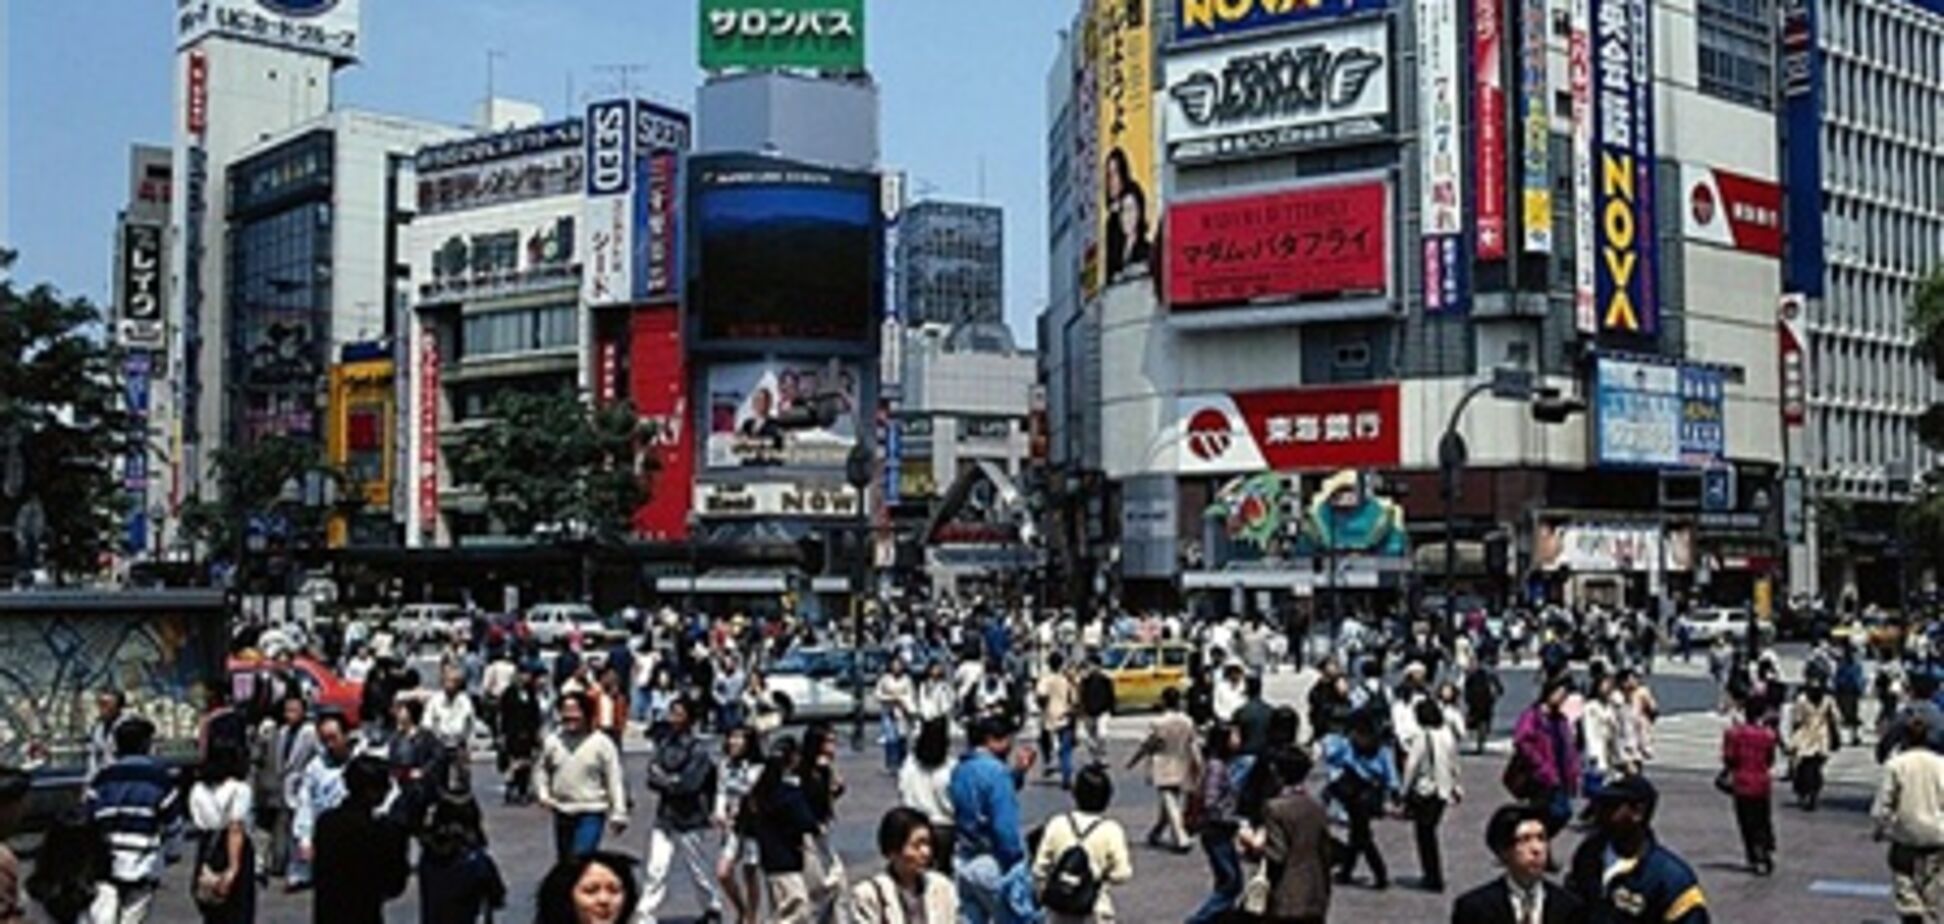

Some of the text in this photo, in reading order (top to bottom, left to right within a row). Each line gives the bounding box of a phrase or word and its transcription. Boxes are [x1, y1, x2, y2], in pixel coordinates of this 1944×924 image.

[708, 8, 855, 37] サロンパス
[593, 106, 625, 191] SEED
[1602, 151, 1638, 330] NOVA
[1265, 409, 1380, 445] 東海銀行
